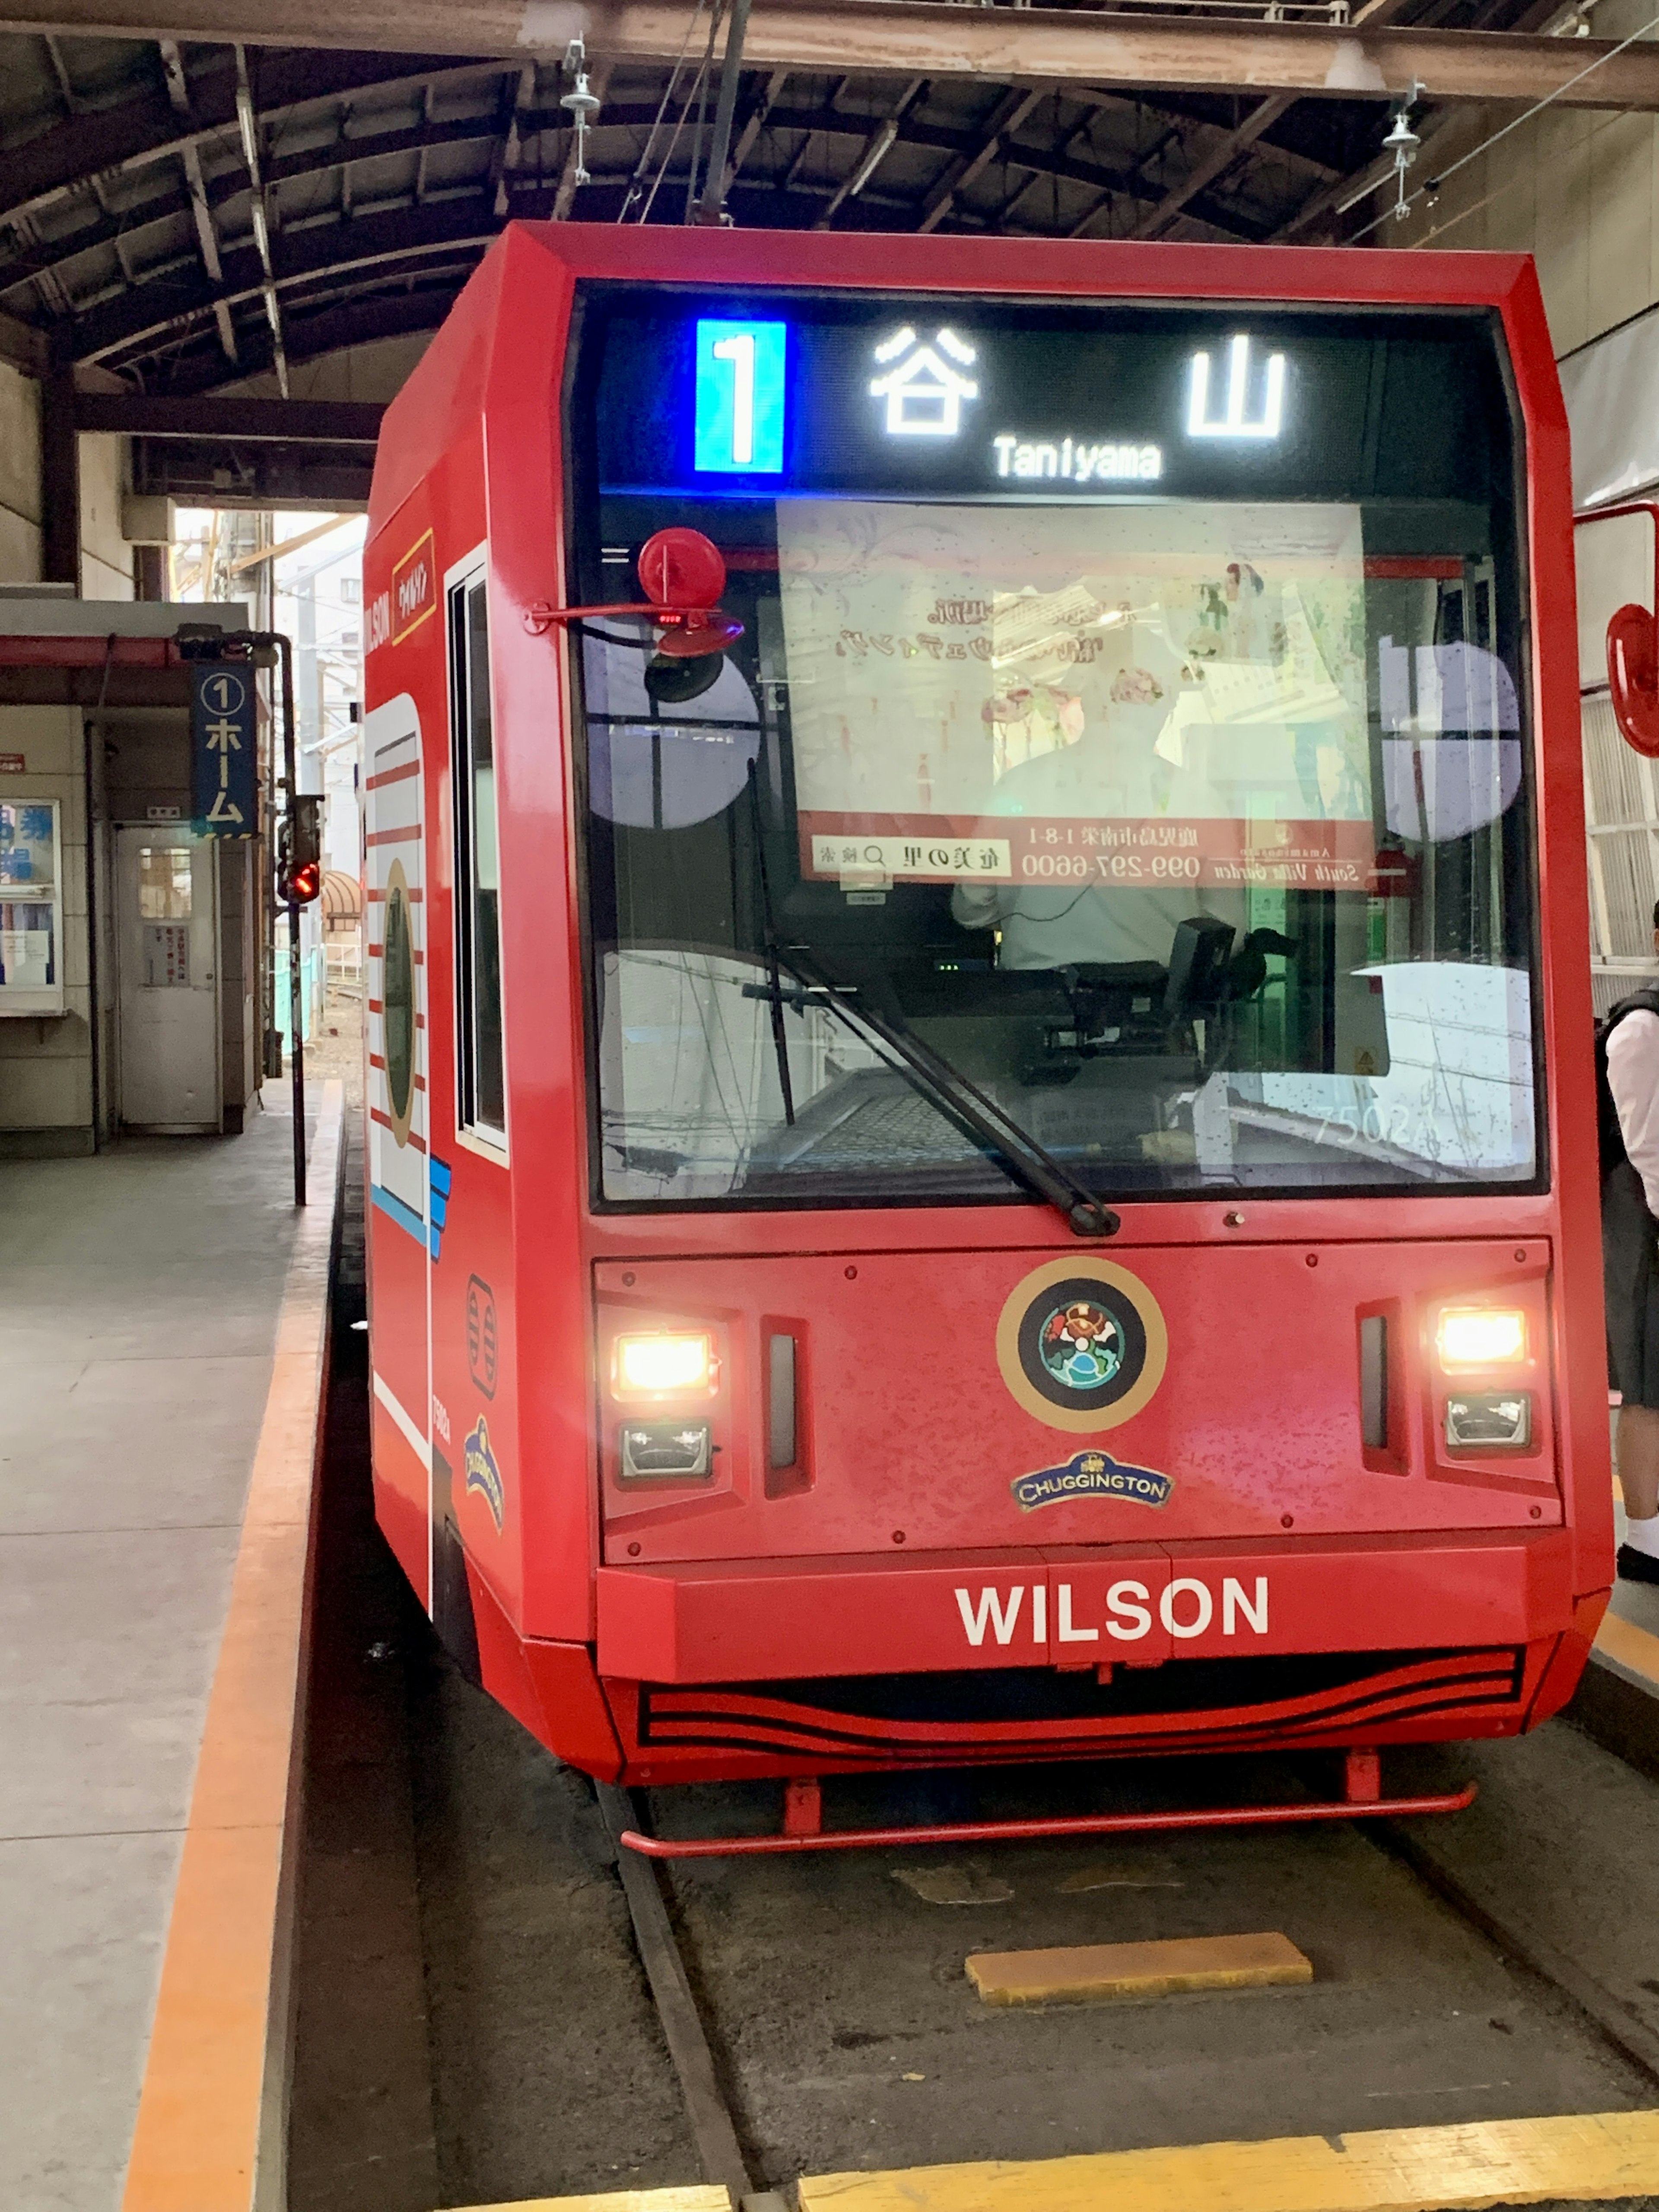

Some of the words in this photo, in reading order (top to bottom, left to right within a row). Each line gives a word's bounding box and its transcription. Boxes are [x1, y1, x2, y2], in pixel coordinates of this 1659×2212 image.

[713, 334, 756, 464] 1
[993, 435, 1162, 481] Taniyama
[1018, 1474, 1166, 1505] CHUGGINGTON
[954, 1577, 1268, 1646] WILSON
